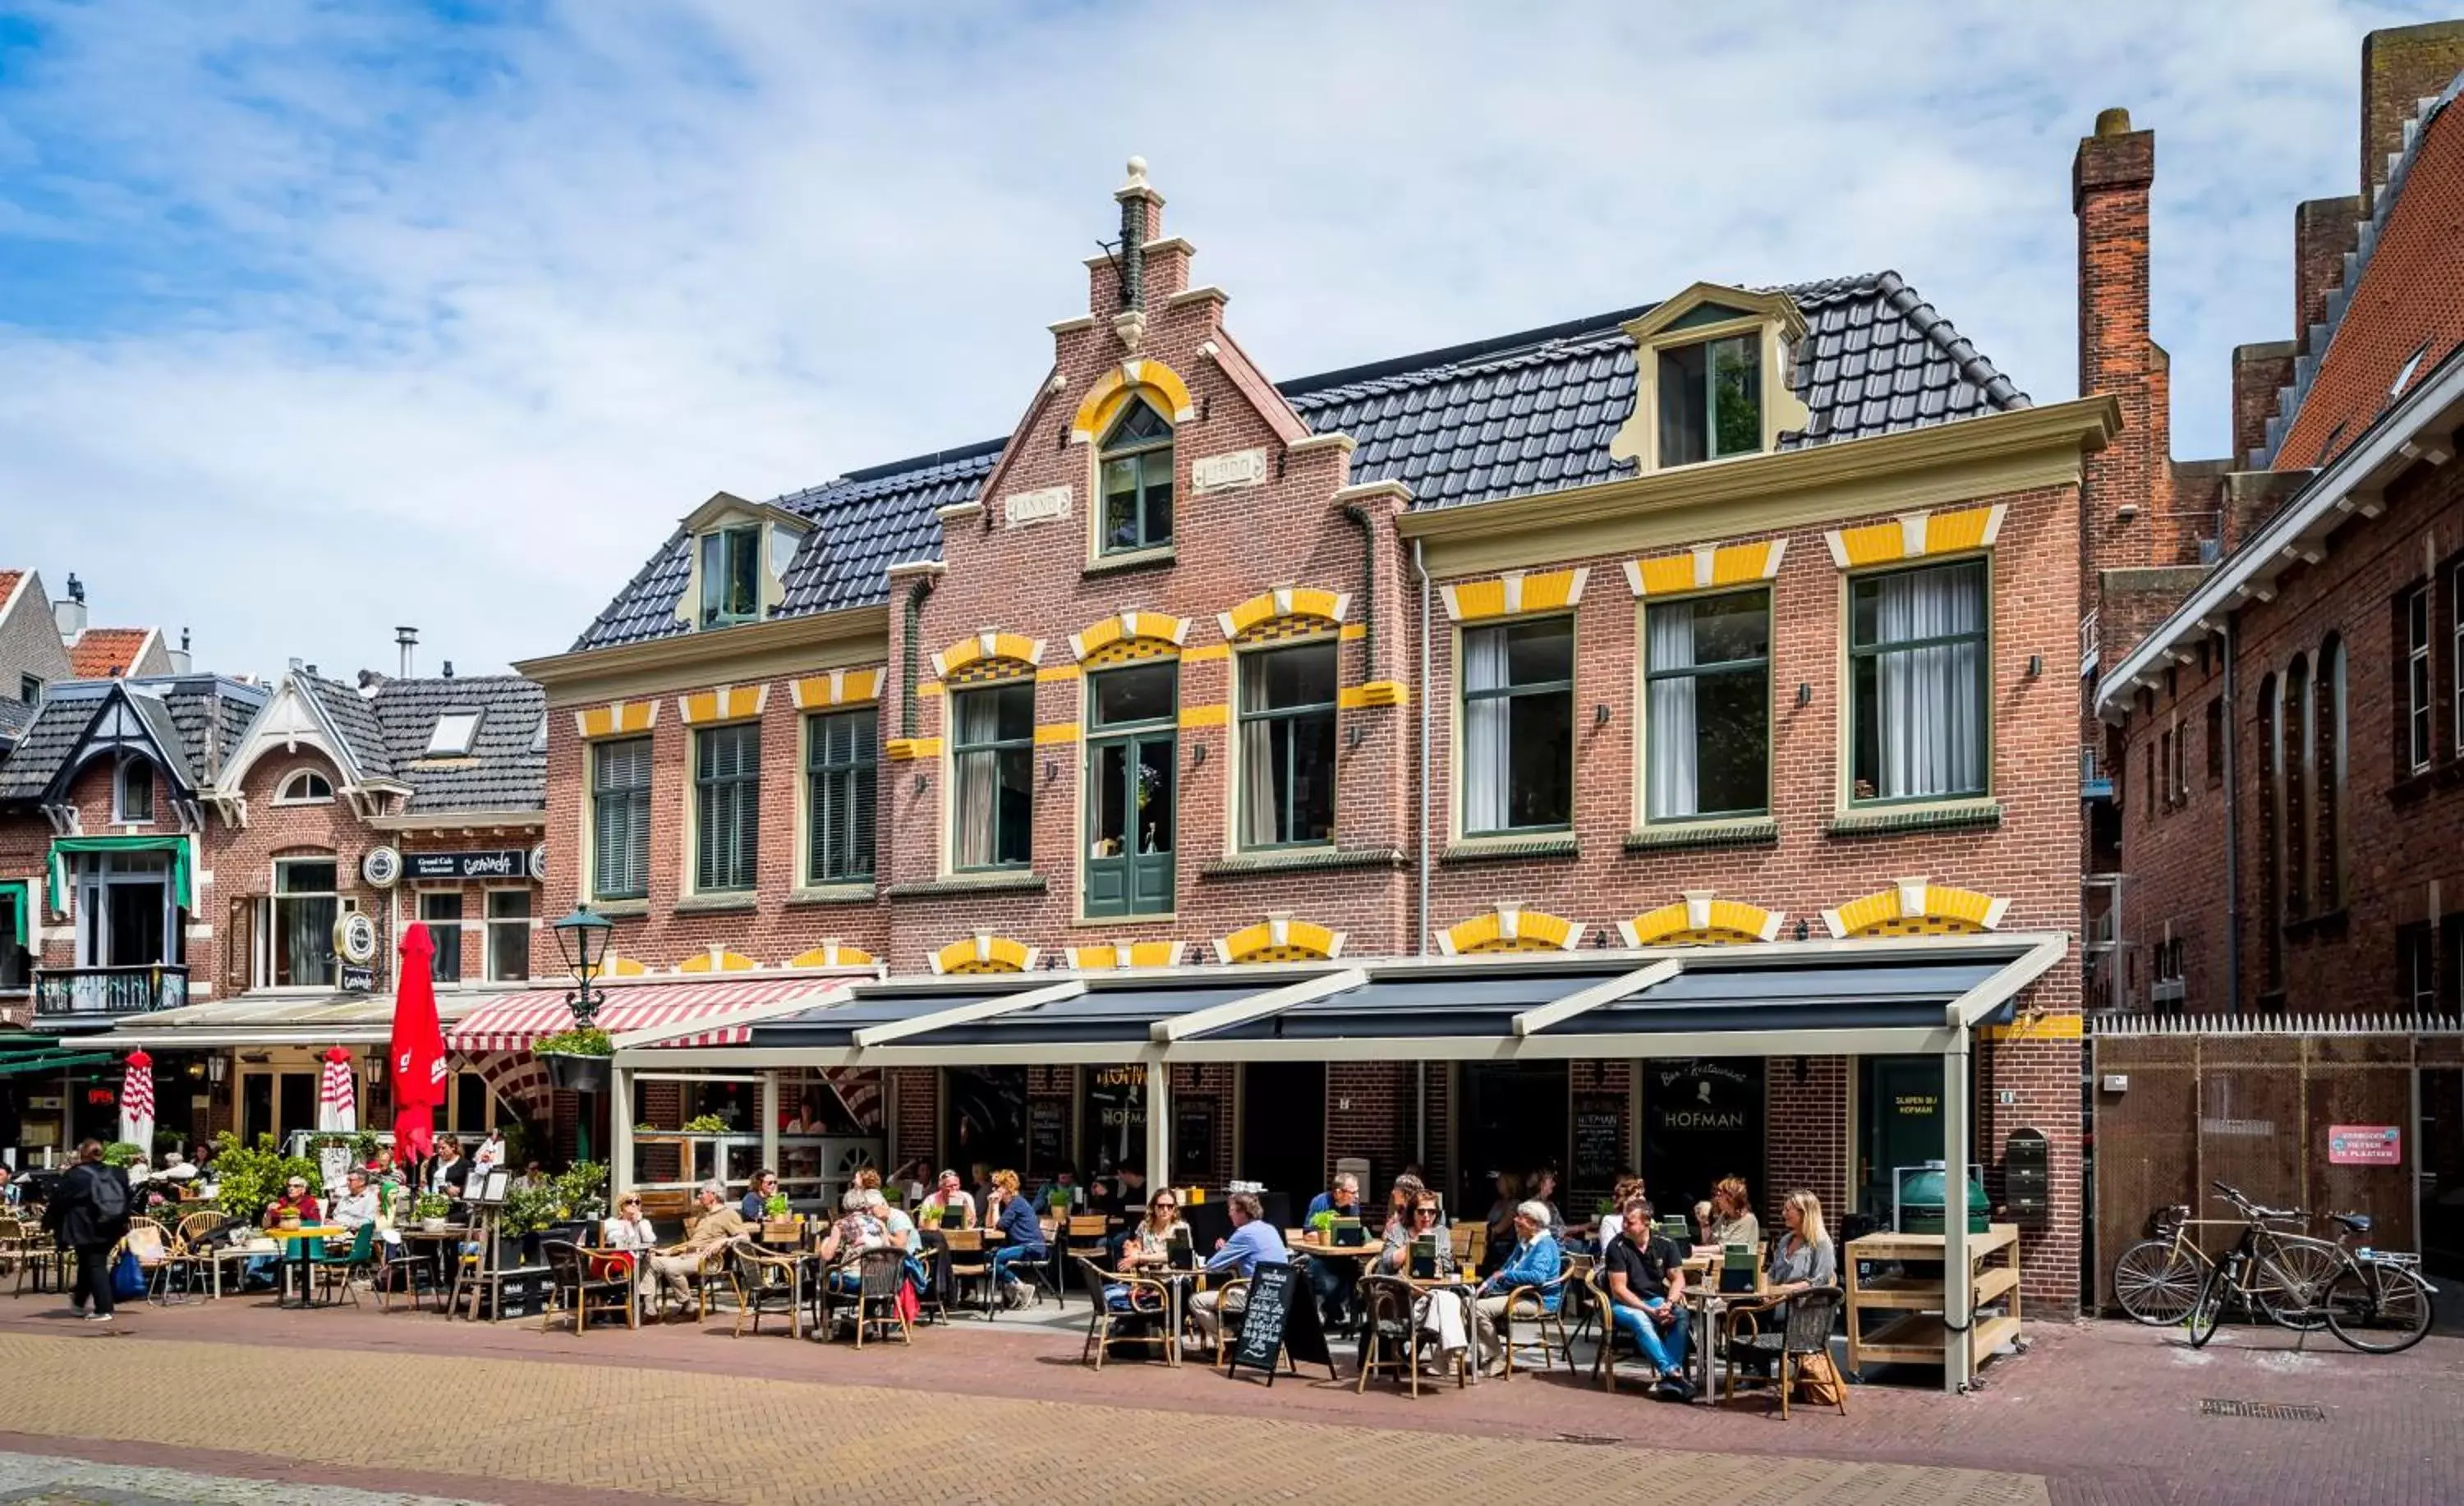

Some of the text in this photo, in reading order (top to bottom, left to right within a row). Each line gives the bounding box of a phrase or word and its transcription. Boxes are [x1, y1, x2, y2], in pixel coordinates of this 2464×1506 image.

[1895, 1096, 1924, 1104] SLAPEN
[1899, 1106, 1933, 1114] HOFMAN
[1665, 1112, 1743, 1127] HOFMAN
